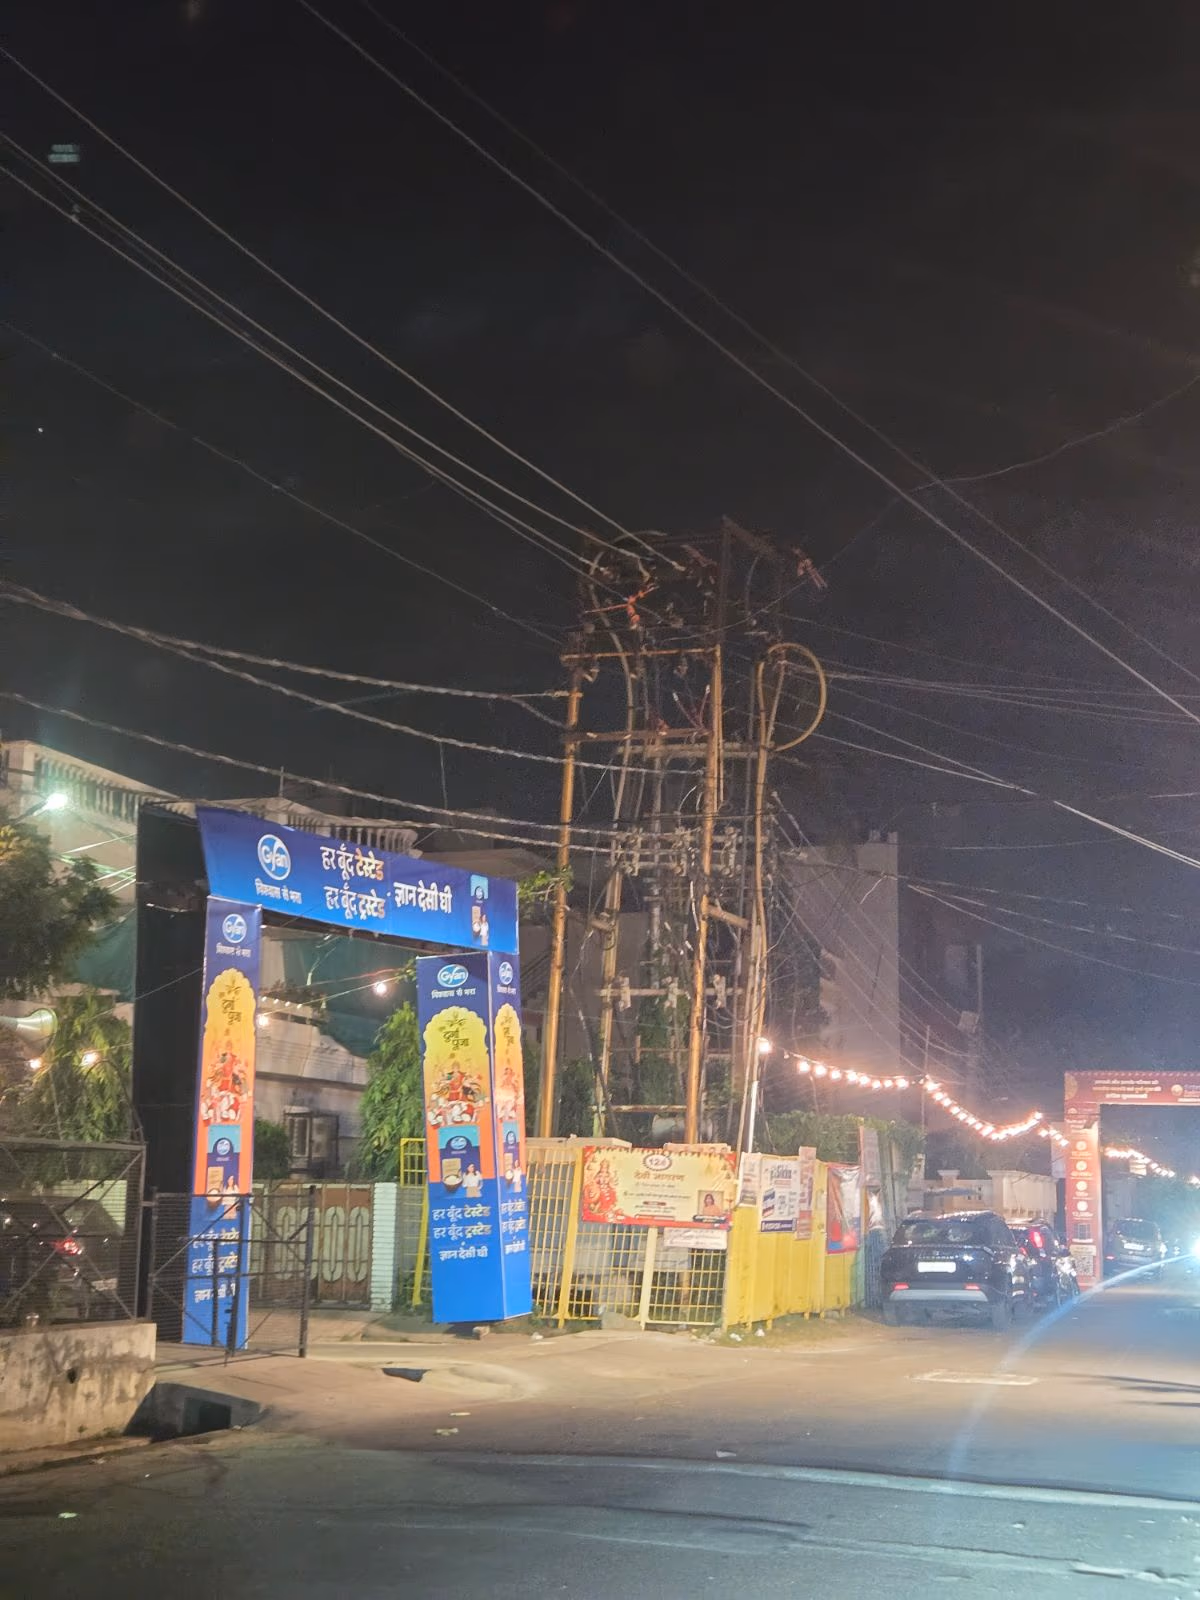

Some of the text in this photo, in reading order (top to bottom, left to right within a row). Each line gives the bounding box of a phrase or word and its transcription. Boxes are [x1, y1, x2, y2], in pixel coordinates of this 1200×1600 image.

[320, 843, 385, 881] हर बूँद टेस्टेड
[323, 882, 386, 920] हर बूँद ट्रस्टेड
[393, 879, 452, 914] ज्ञान देसी घी
[441, 966, 466, 985] Gyan
[432, 1208, 446, 1220] हर
[447, 1204, 463, 1222] बूँद
[463, 1203, 491, 1218] टेस्टेड
[433, 1227, 447, 1239] हर
[447, 1223, 463, 1240] बूँद
[438, 1249, 457, 1261] ज्ञान
[458, 1246, 475, 1260] देसी
